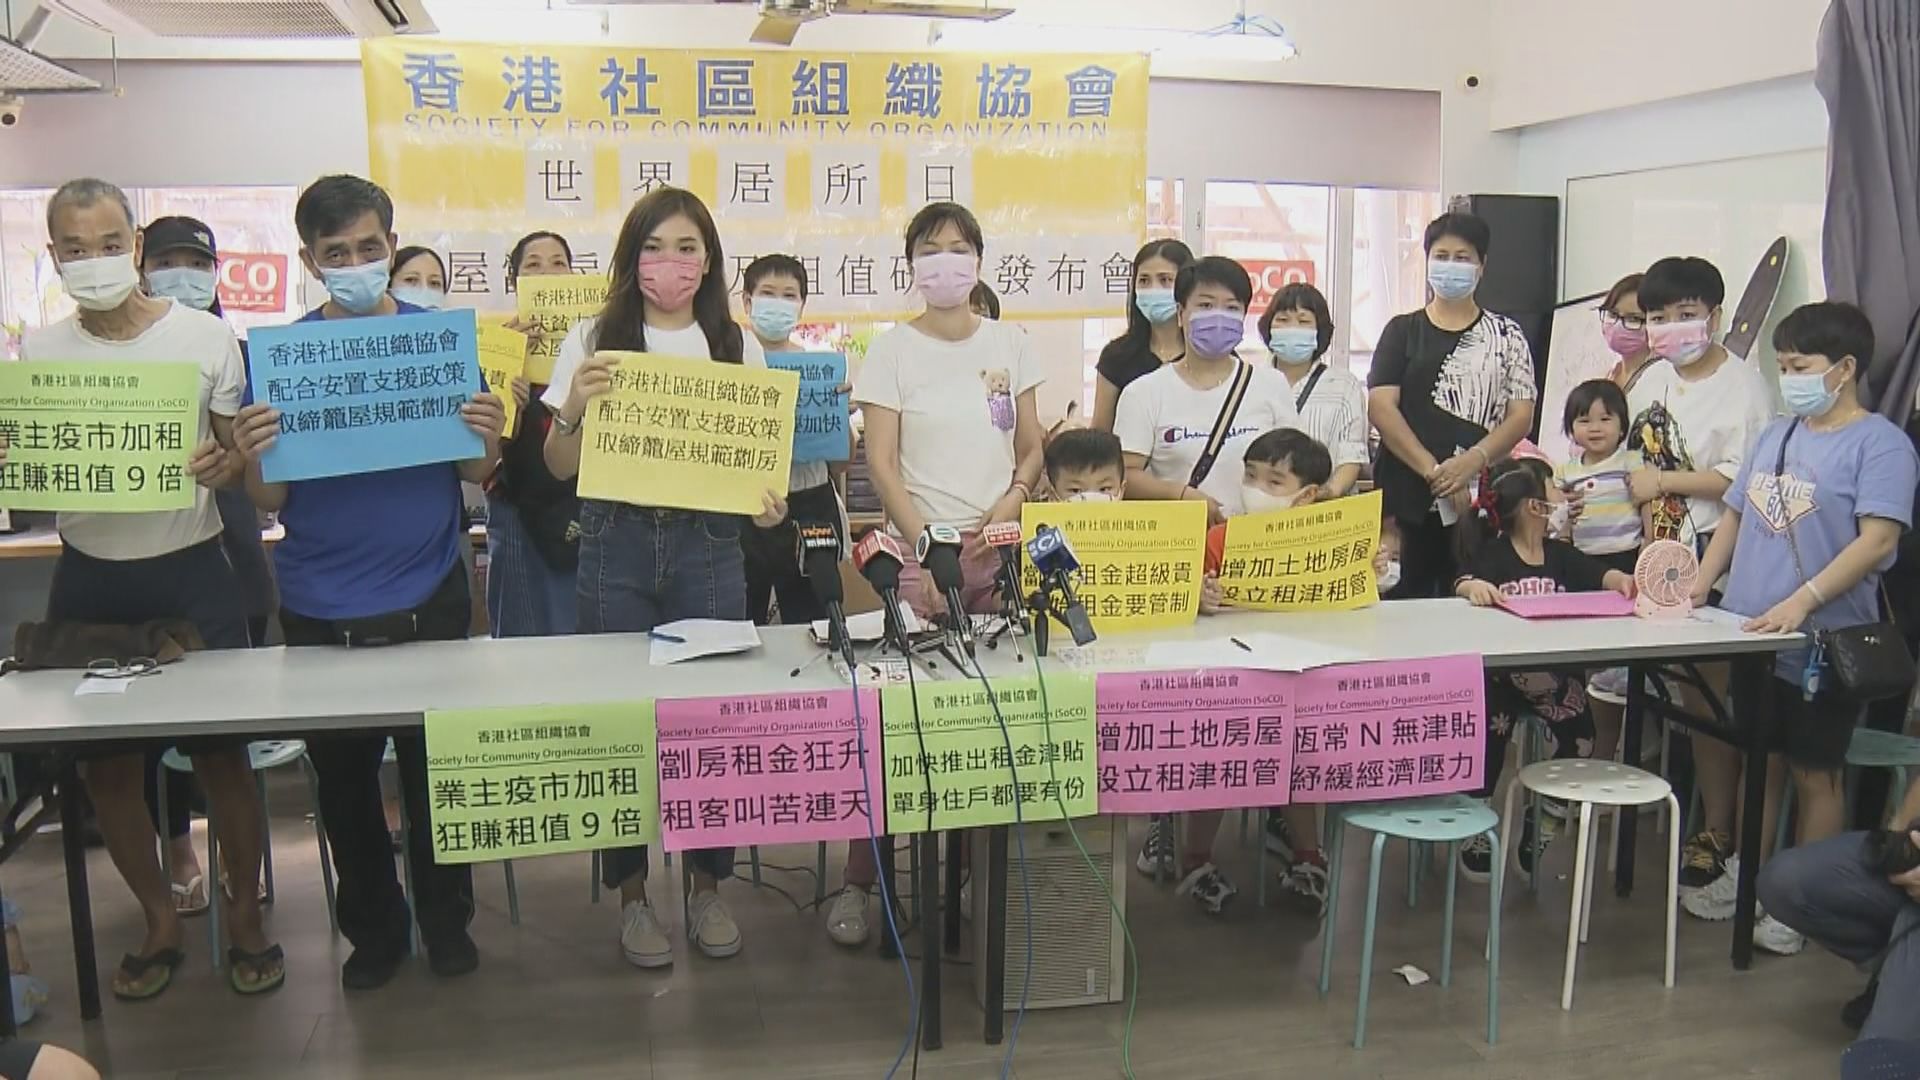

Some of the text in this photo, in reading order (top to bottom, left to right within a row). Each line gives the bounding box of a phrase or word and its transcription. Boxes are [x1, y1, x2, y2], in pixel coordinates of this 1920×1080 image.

[402, 52, 1117, 118] 香港社區組織協會
[404, 114, 1108, 140] SOCIETY FOR COMMUNITY ORGANIZATION
[538, 159, 955, 206] 世界居所日
[268, 328, 459, 367] 香港社區組織協會
[31, 373, 139, 389] 香港社區組織協會
[267, 361, 467, 402] 配合安置支援政策
[608, 369, 782, 408] 香港社區組織協會
[33, 396, 88, 408] Community
[90, 397, 155, 409] Organization
[0, 419, 183, 451] 業主疫市加租
[598, 400, 782, 441] 配合安置支援政策
[596, 432, 778, 472] 取締籠屋規範劏房
[127, 465, 146, 492] 9
[157, 463, 183, 493] 倍
[1072, 539, 1113, 549] ommunity
[1220, 538, 1371, 578] 增加土地房屋
[1023, 562, 1192, 587] 當租金超級貴
[933, 688, 1038, 709] 香港社區組織協會
[1140, 675, 1239, 691] 香港社區組織協會
[1337, 672, 1431, 692] 香港社區組織協會
[719, 696, 828, 715] 香港社區組織協會
[1096, 695, 1284, 712] ociety for Community Organization (SoCO)
[1325, 700, 1338, 711] for
[1339, 698, 1389, 710] Community
[1391, 693, 1445, 705] Organization
[1447, 689, 1473, 700] (SoCO)
[478, 725, 591, 743] 香港社區組織協會
[657, 727, 692, 738] Society
[695, 727, 709, 736] for
[711, 724, 768, 735] Community
[770, 720, 833, 732] Organization
[921, 719, 934, 729] for
[937, 715, 992, 727] Community
[993, 711, 1053, 723] Organization
[1055, 707, 1087, 718] (SoCO)
[1097, 716, 1282, 752] 增加土地房屋
[1295, 710, 1477, 754] 恆常 N 無津貼
[465, 753, 479, 764] for
[482, 750, 540, 763] Community
[542, 746, 607, 758] Organization
[609, 743, 644, 755] (SoCO)
[660, 738, 869, 780] 劏房租金狂升
[891, 739, 1084, 778] 加快推出租金津貼
[434, 767, 639, 810] 業主疫市加租
[1097, 758, 1280, 793] 設立租津租管
[1292, 752, 1473, 791] 紓緩經濟壓力
[662, 789, 870, 831] 租客叫苦連天
[892, 777, 1085, 814] 單身住戶都要有份
[436, 808, 641, 852] 狂賺租值 9 倍
